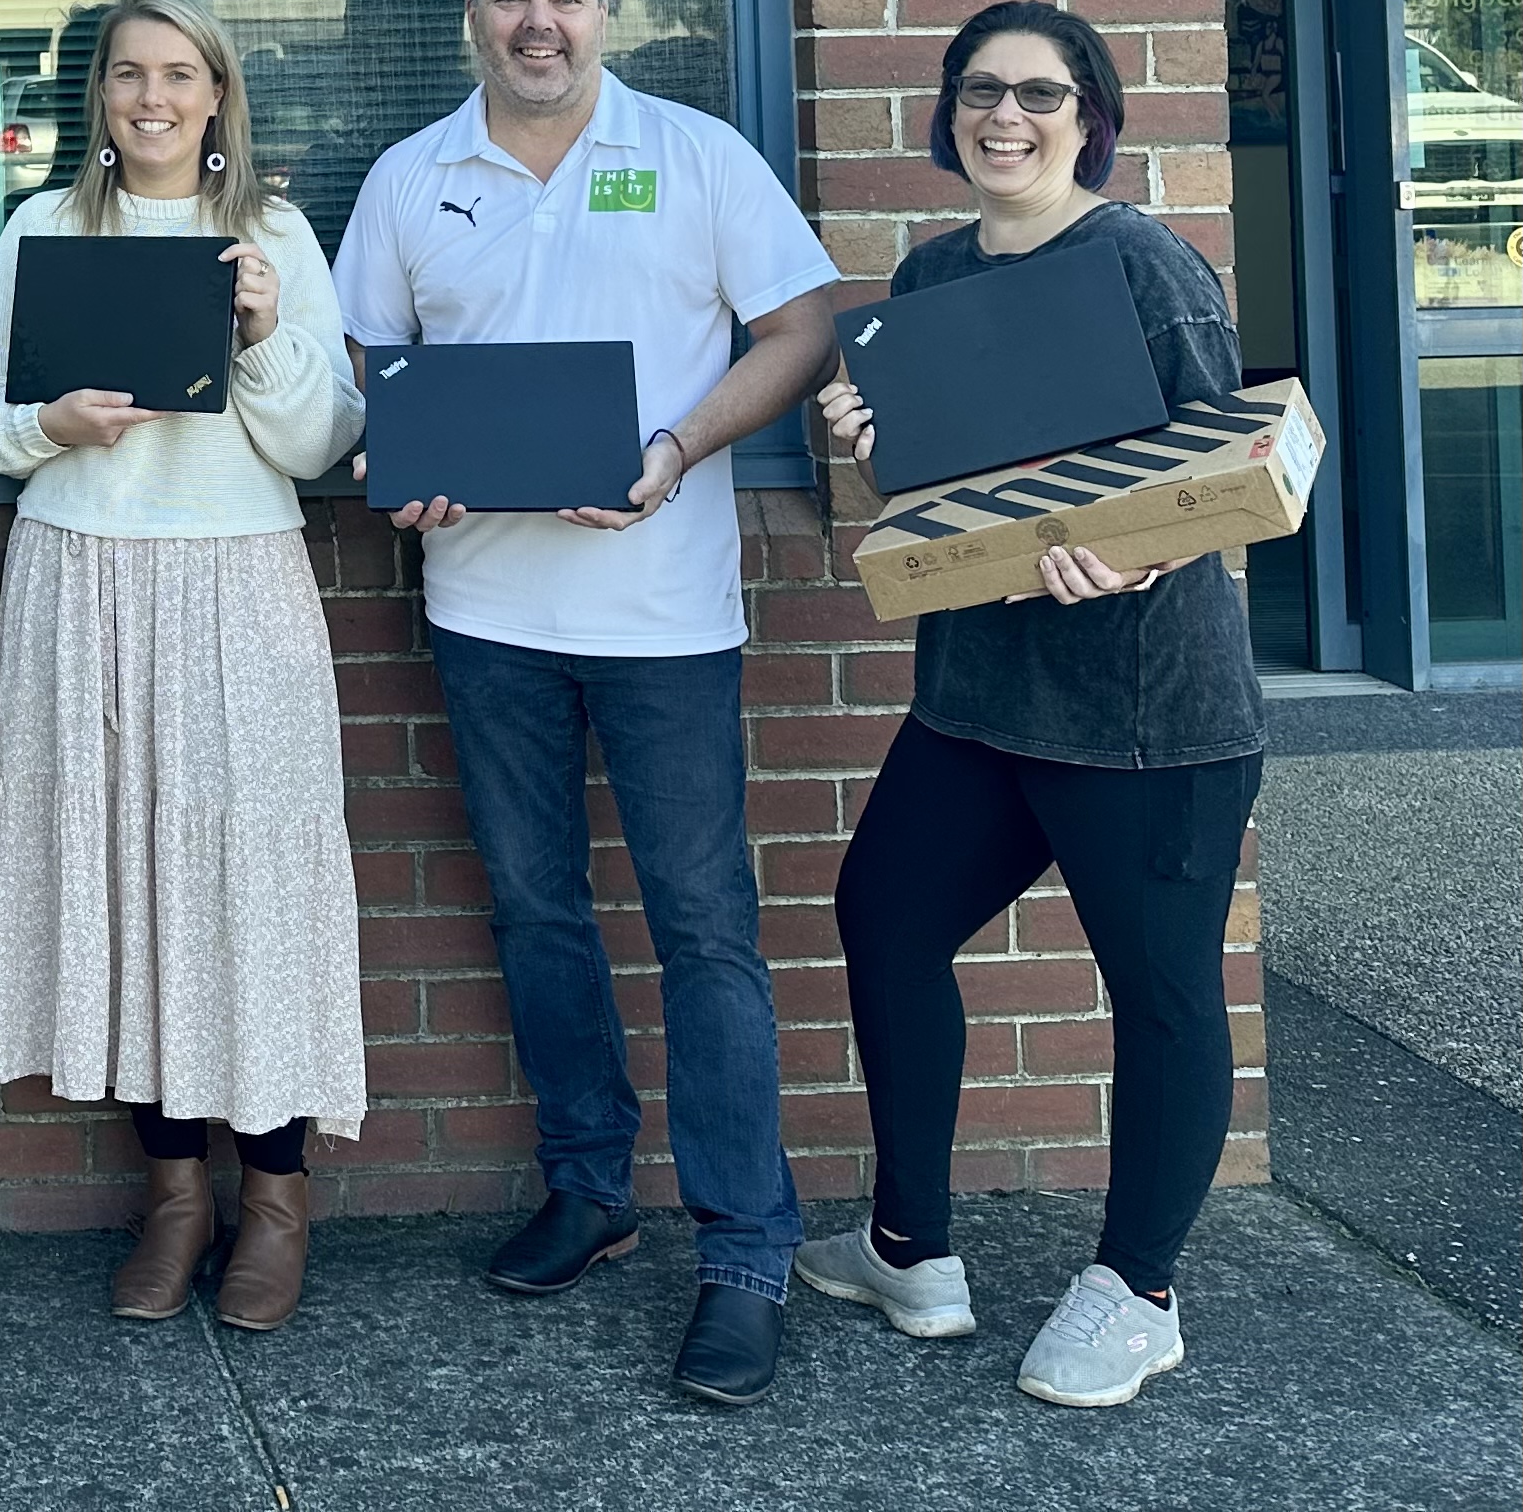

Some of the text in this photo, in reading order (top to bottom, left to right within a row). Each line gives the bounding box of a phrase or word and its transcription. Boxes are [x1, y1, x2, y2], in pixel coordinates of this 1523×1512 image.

[594, 169, 637, 181] THIS
[595, 183, 643, 195] IS IT
